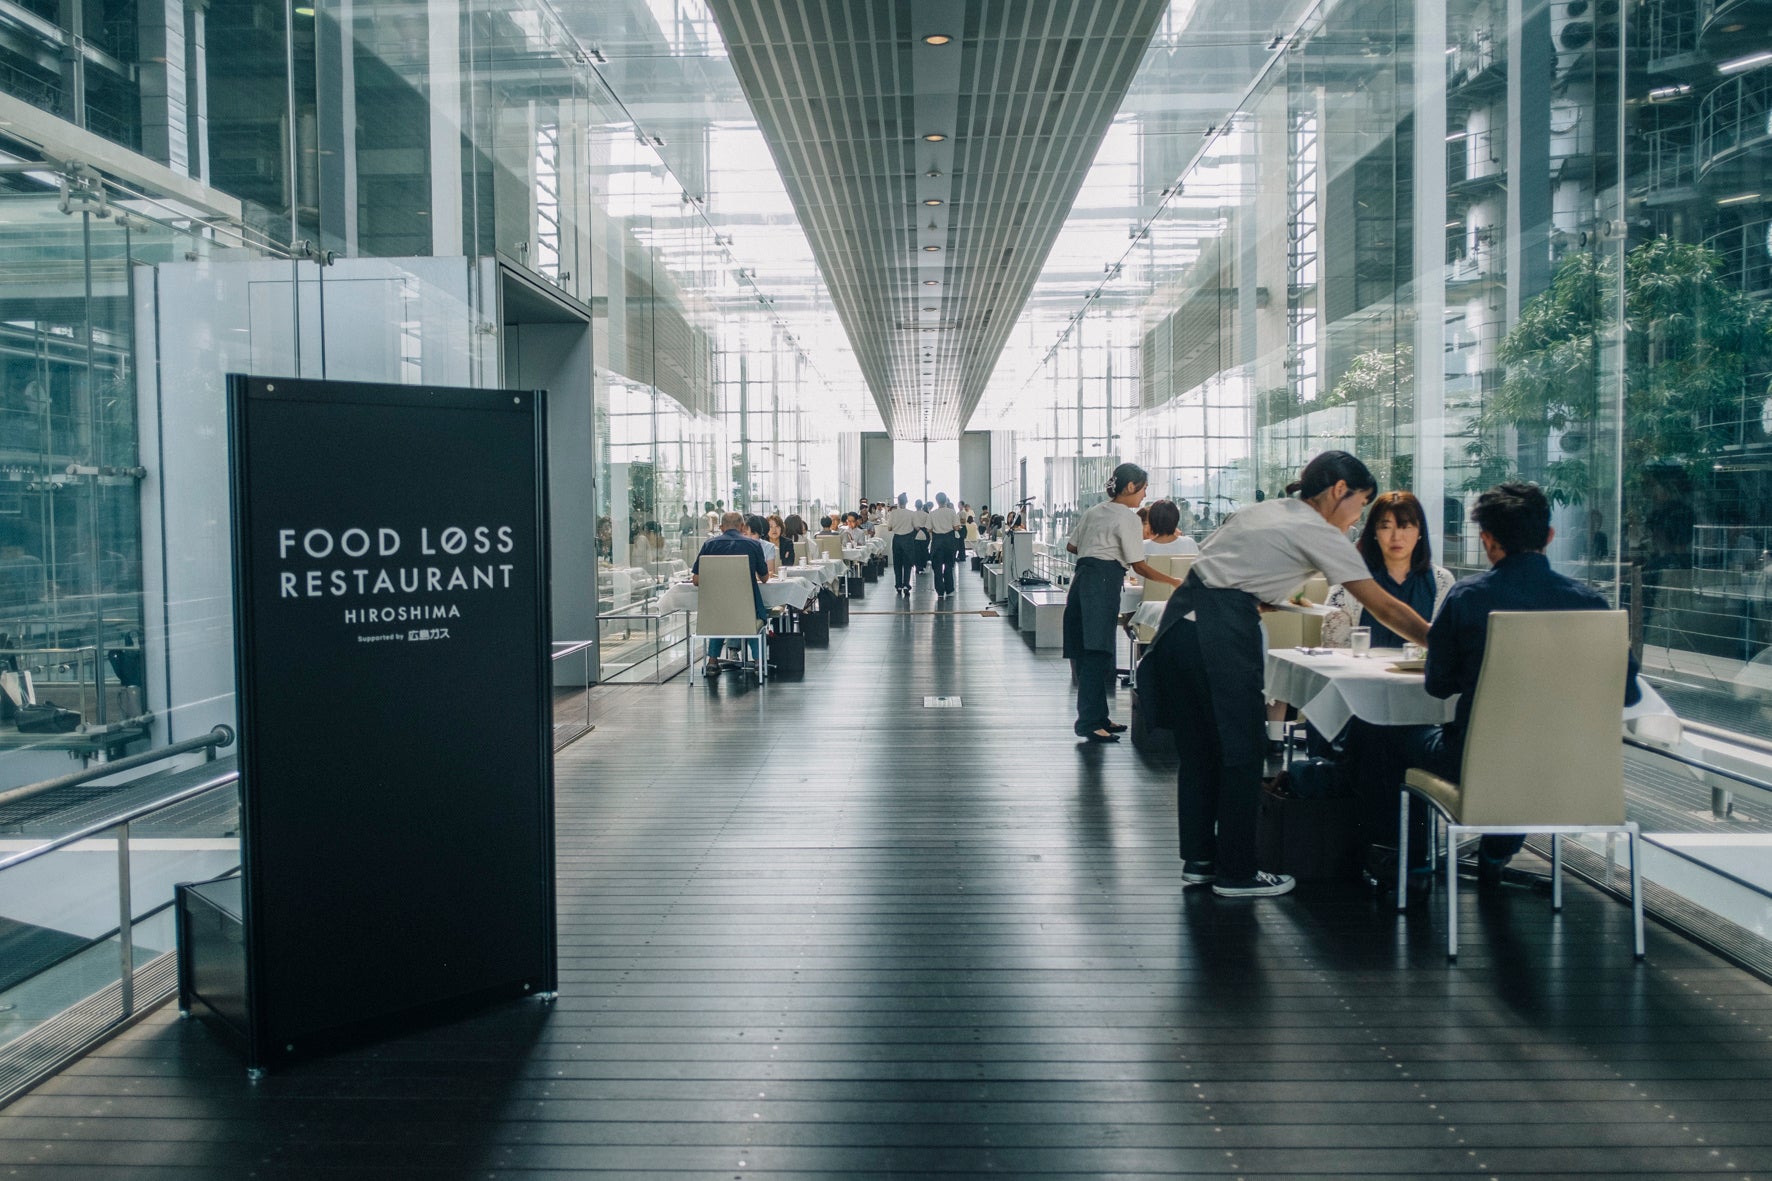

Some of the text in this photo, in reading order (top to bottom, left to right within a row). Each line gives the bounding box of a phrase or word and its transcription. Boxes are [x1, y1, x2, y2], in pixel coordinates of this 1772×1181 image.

[279, 528, 401, 559] FOOD
[280, 564, 514, 598] RESTAURANT
[344, 604, 461, 624] HIROSHIMA
[357, 633, 405, 643] Supported by
[407, 628, 450, 642] 広島ガス
